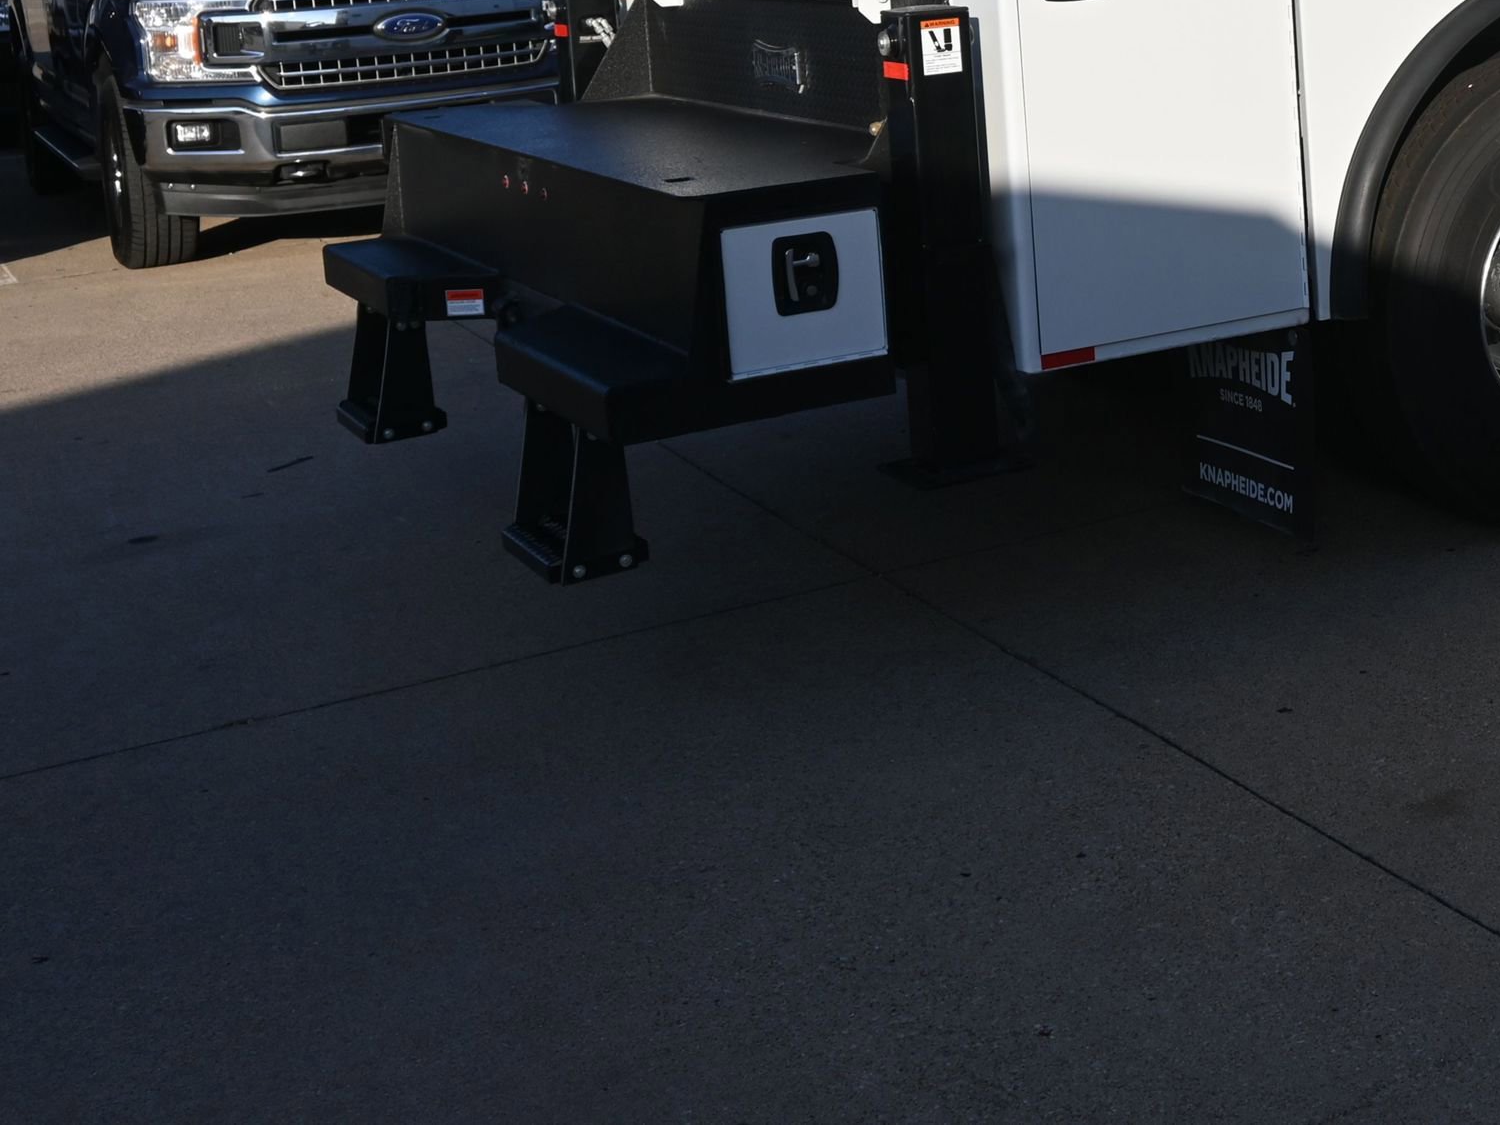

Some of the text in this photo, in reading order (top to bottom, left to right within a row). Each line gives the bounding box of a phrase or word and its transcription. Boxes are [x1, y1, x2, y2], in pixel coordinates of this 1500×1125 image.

[1187, 345, 1295, 406] KNAPHEIDE
[1219, 387, 1263, 412] SINCE 1848
[1199, 461, 1294, 515] KNAPHEIDE.COM
